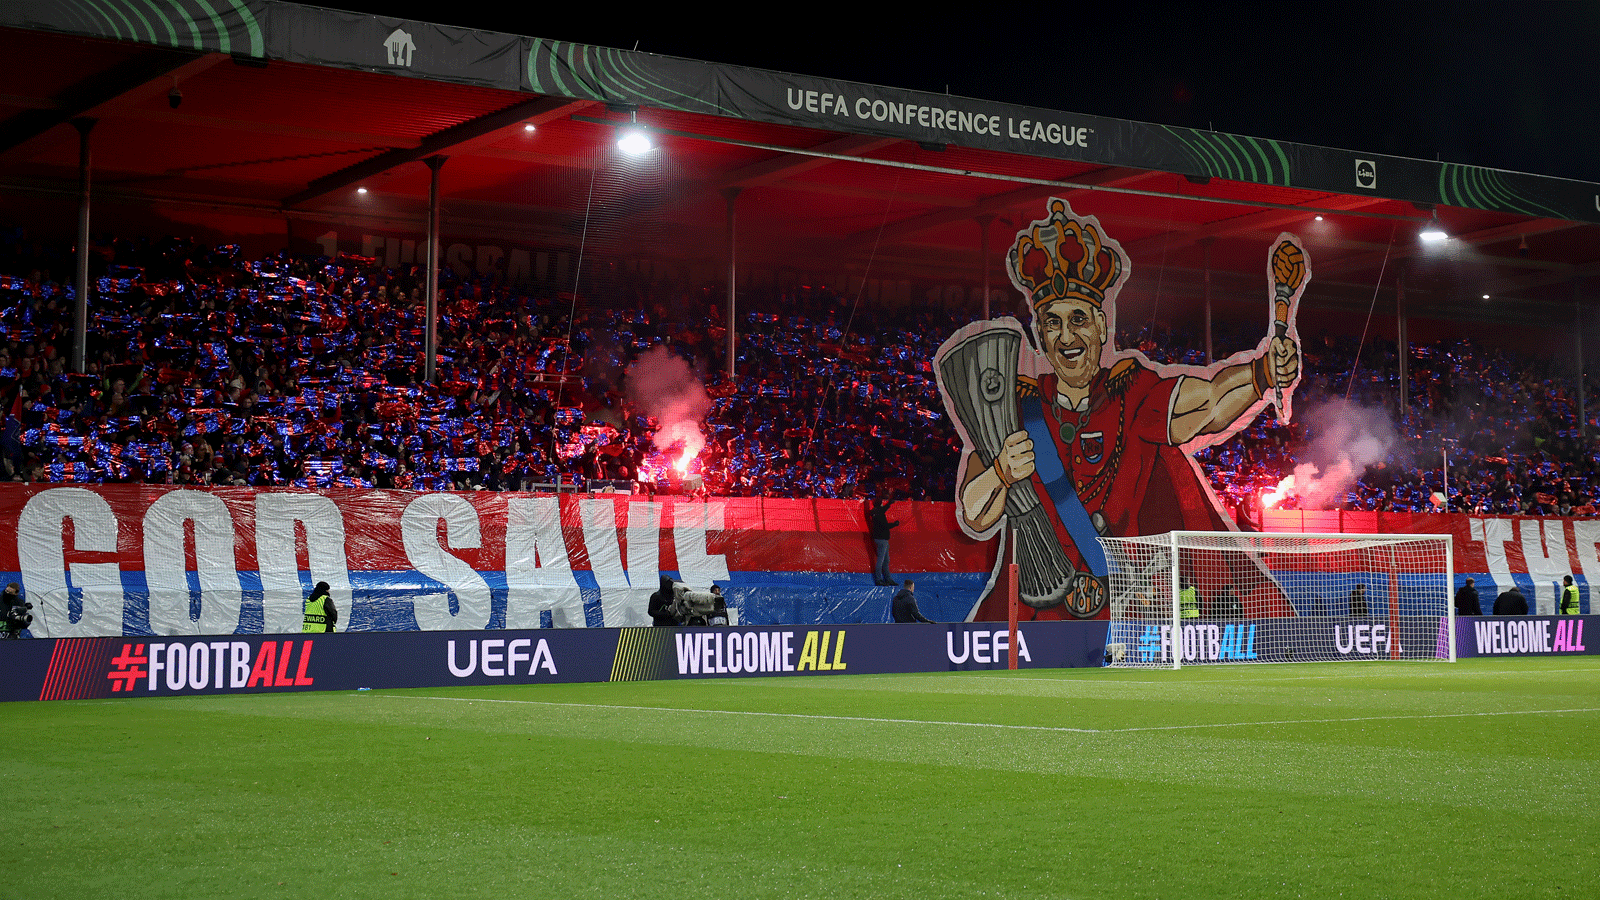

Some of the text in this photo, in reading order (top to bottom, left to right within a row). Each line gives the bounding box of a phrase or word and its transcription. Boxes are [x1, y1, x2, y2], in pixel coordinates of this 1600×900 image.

[787, 88, 849, 117] UEFA
[855, 97, 1000, 137] CONFERENCE
[17, 487, 352, 637] GOD
[402, 493, 739, 631] SAVE
[303, 615, 325, 623] EWARD
[1475, 619, 1585, 653] WELCOME ALL
[107, 640, 314, 691] #FOOTBALL
[447, 639, 558, 678] UEFA
[675, 630, 847, 674] WELCOME ALL
[946, 630, 1032, 664] UEFA
